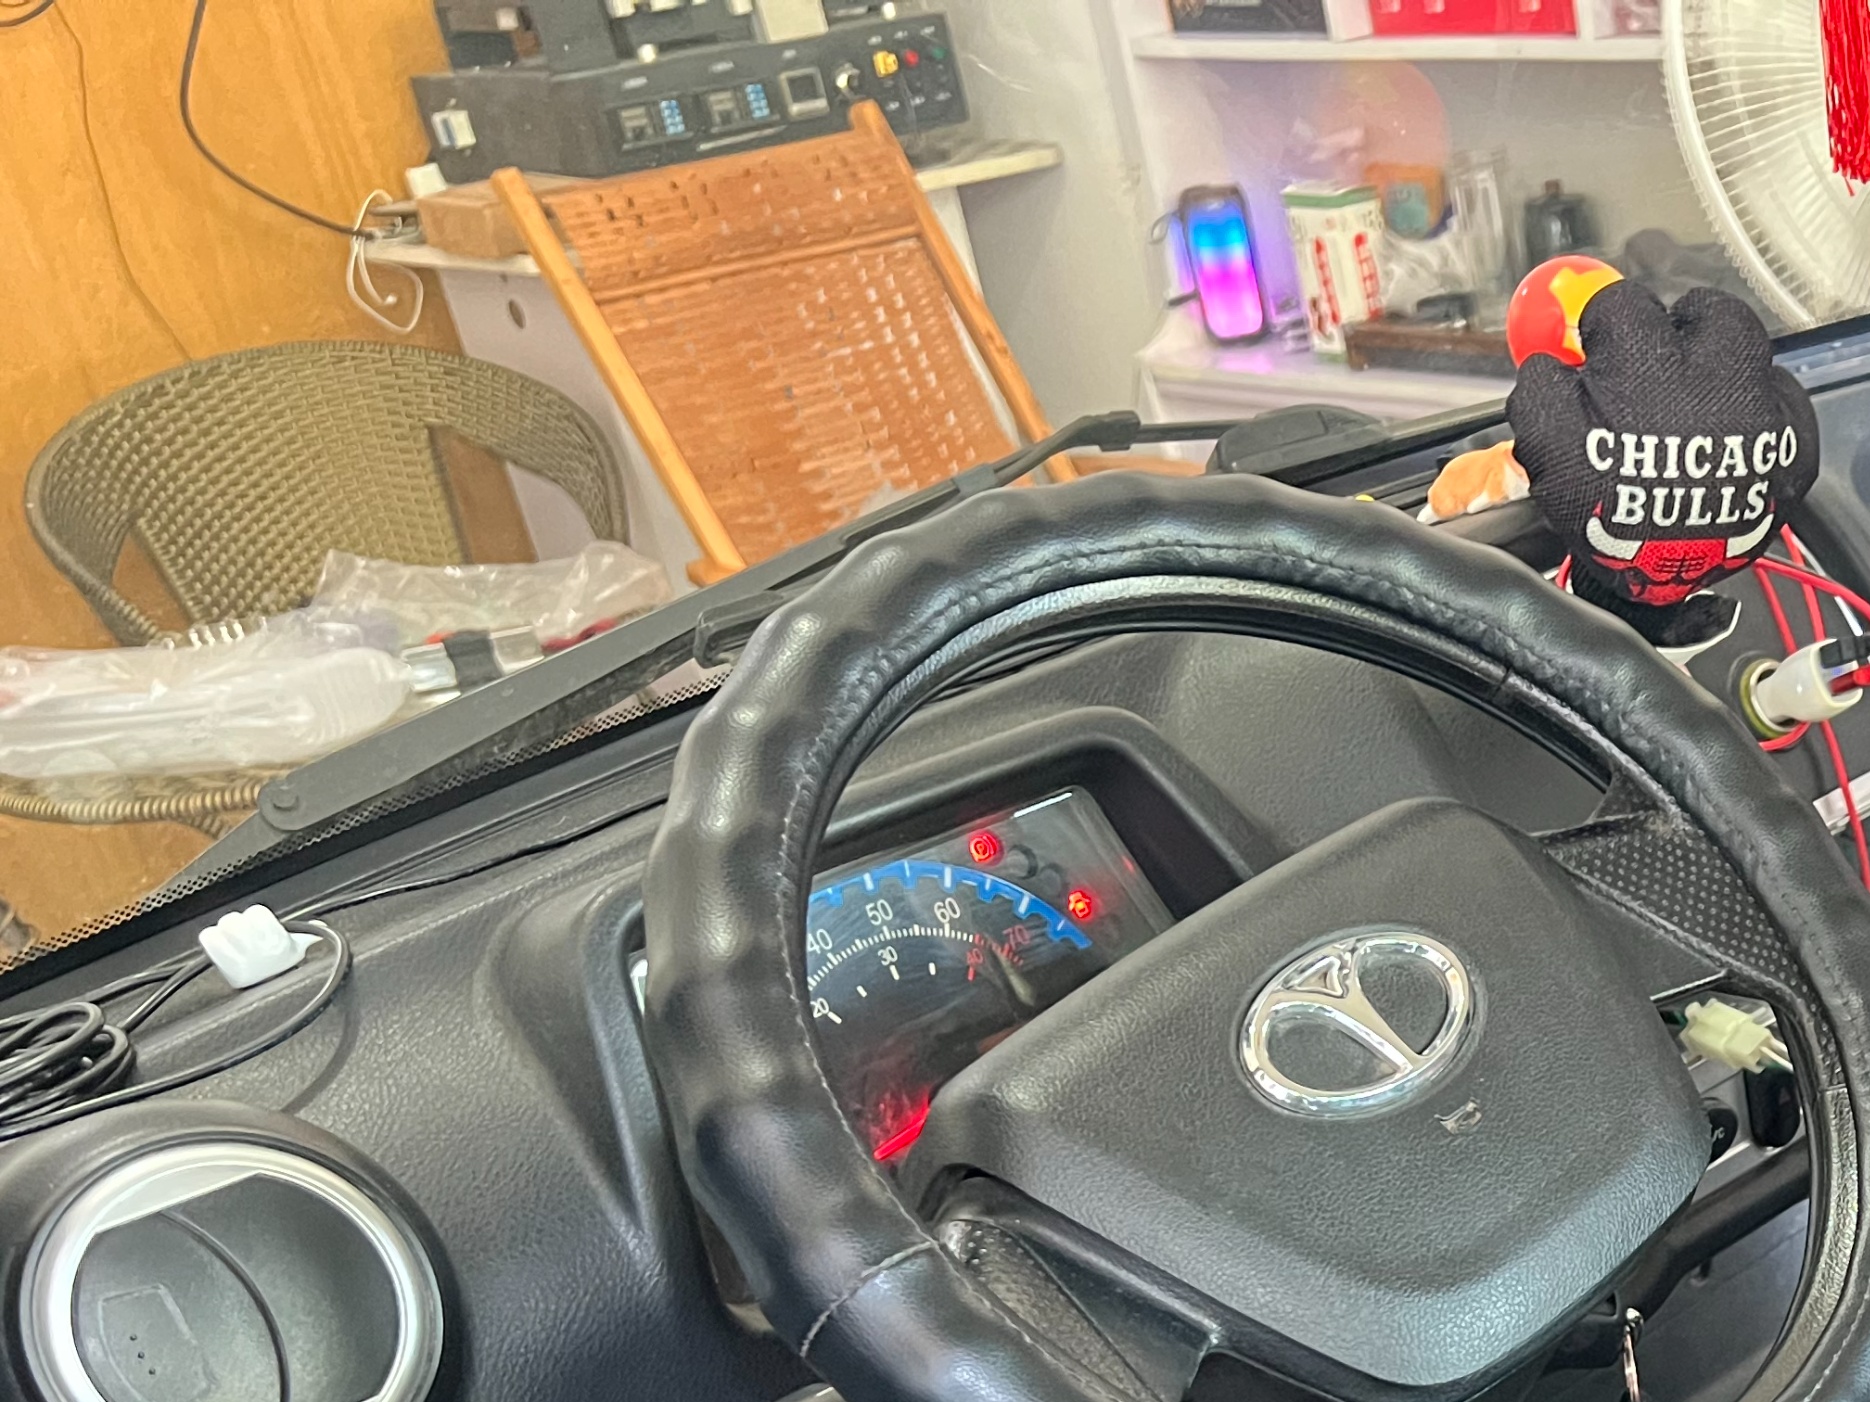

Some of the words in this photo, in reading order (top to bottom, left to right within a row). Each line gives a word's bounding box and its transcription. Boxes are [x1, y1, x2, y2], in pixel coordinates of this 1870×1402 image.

[1585, 425, 1798, 479] CHICAGO
[1611, 480, 1770, 527] BULLS
[865, 899, 893, 926] 50
[933, 897, 961, 924] 60
[807, 928, 833, 954] 40
[877, 945, 898, 966] 30
[810, 997, 830, 1019] 20
